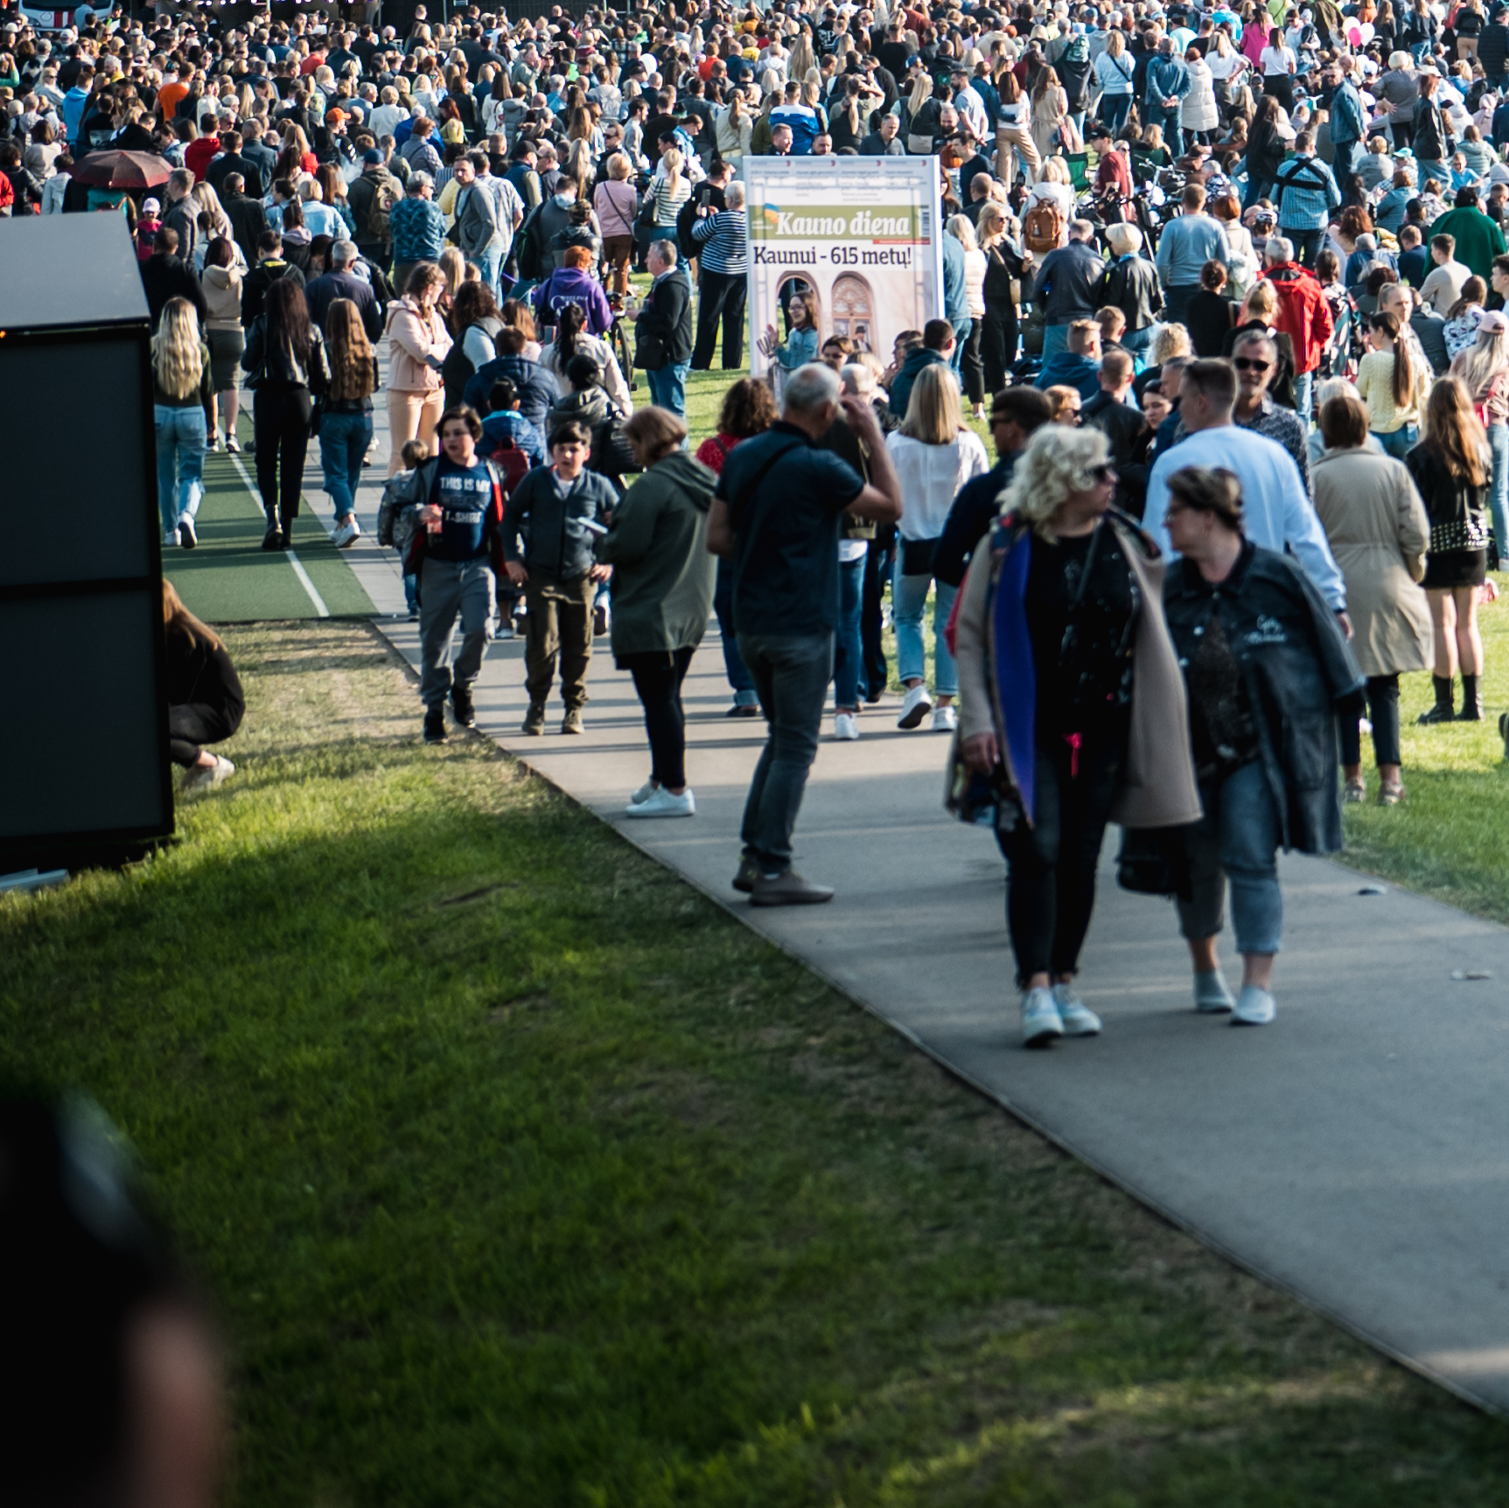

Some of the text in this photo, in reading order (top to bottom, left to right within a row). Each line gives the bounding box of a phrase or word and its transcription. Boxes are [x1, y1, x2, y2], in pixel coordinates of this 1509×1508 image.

[775, 209, 910, 235] Kauno diena
[753, 246, 817, 265] Kaunui
[830, 246, 858, 265] 615
[861, 246, 912, 269] metų!
[440, 476, 491, 493] THIS IS MY
